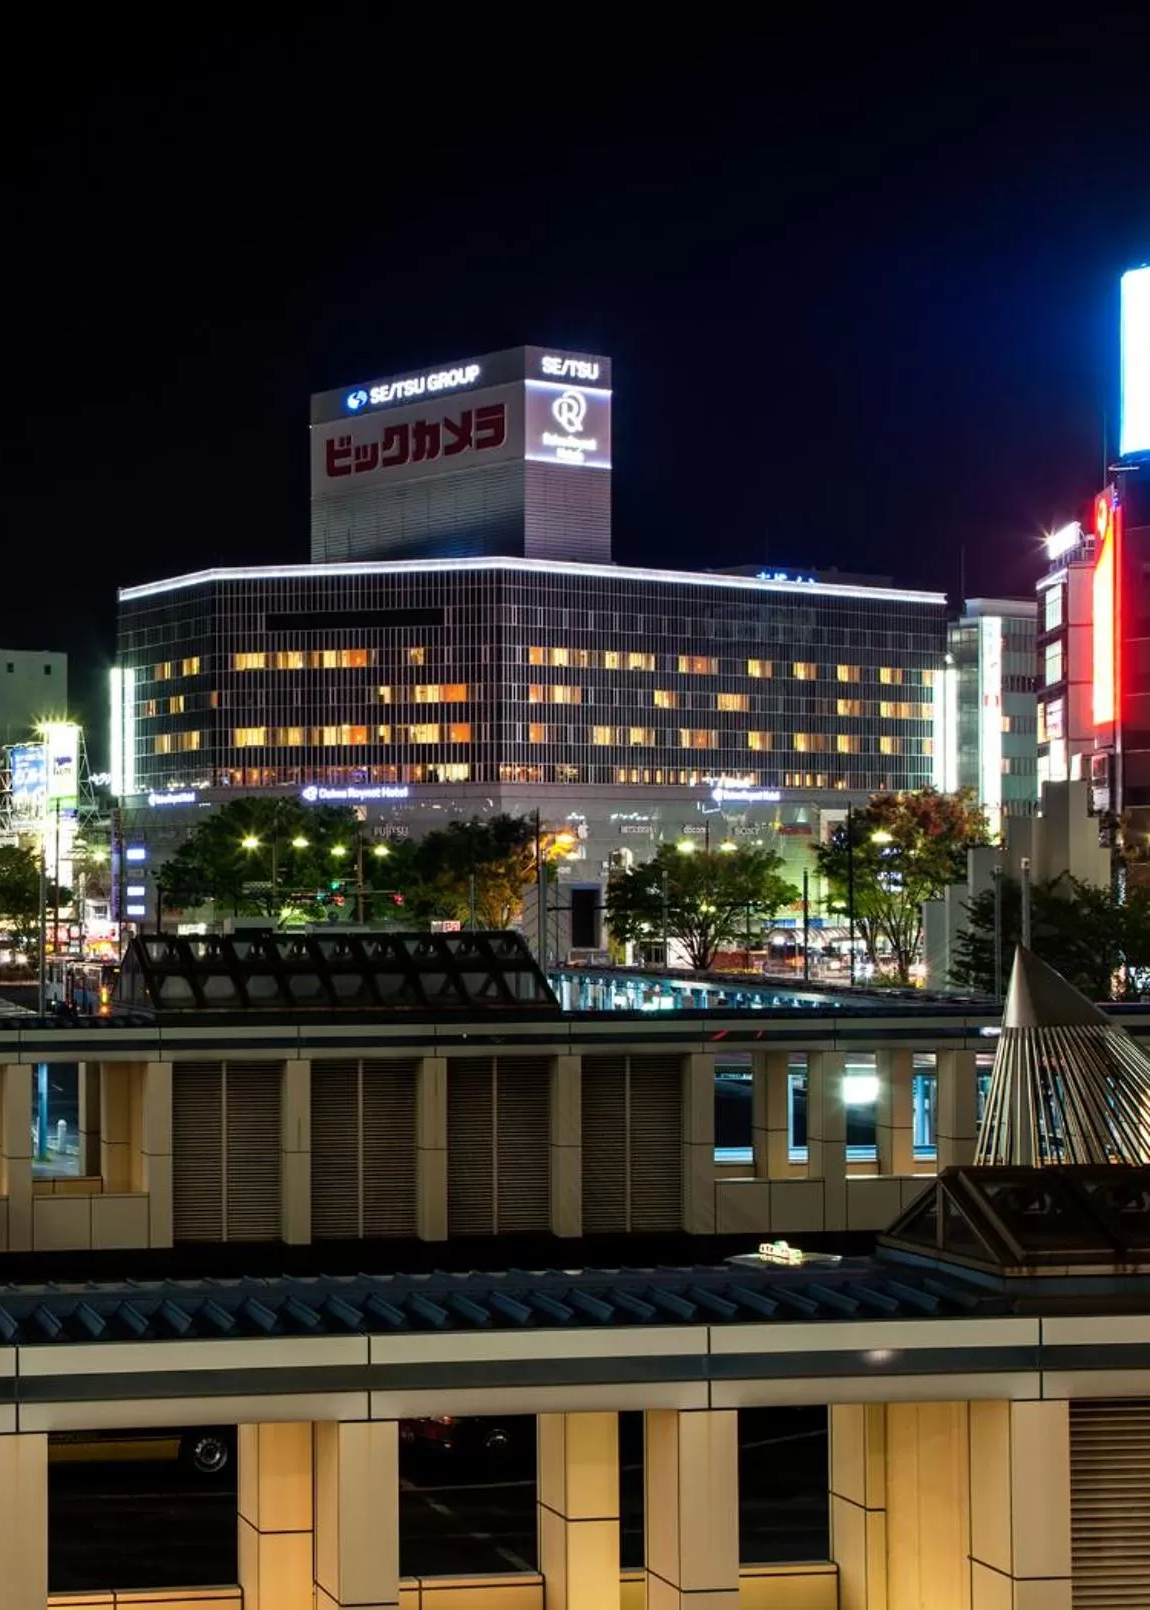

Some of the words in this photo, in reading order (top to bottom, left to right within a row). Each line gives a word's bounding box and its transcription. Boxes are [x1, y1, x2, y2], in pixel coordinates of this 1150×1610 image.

[427, 365, 481, 391] GROUP
[326, 402, 507, 478] ビックカメラ
